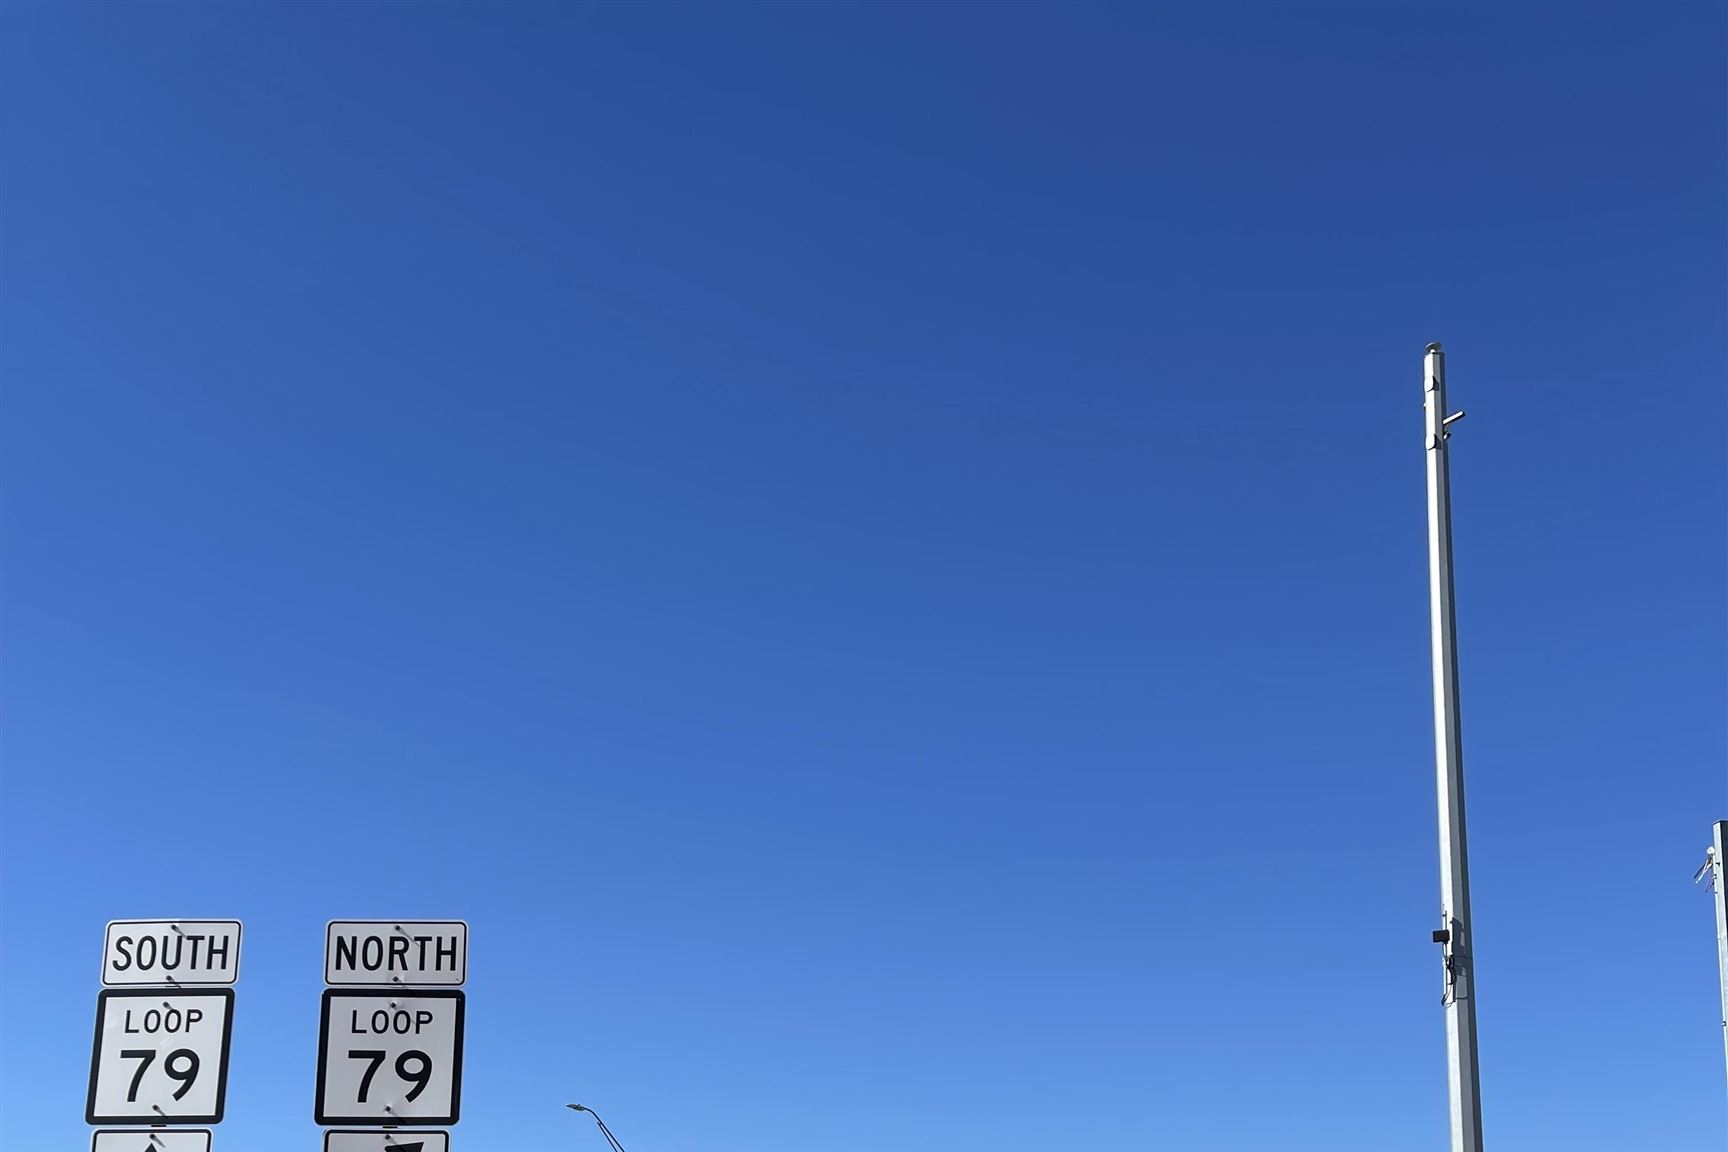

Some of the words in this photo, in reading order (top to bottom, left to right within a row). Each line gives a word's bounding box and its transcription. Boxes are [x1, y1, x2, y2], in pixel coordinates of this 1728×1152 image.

[112, 935, 229, 971] SOUTH
[335, 935, 457, 971] NORTH
[124, 1009, 203, 1034] LOOP
[351, 1009, 433, 1035] LOOP
[120, 1048, 200, 1102] 79
[348, 1050, 432, 1103] 79
